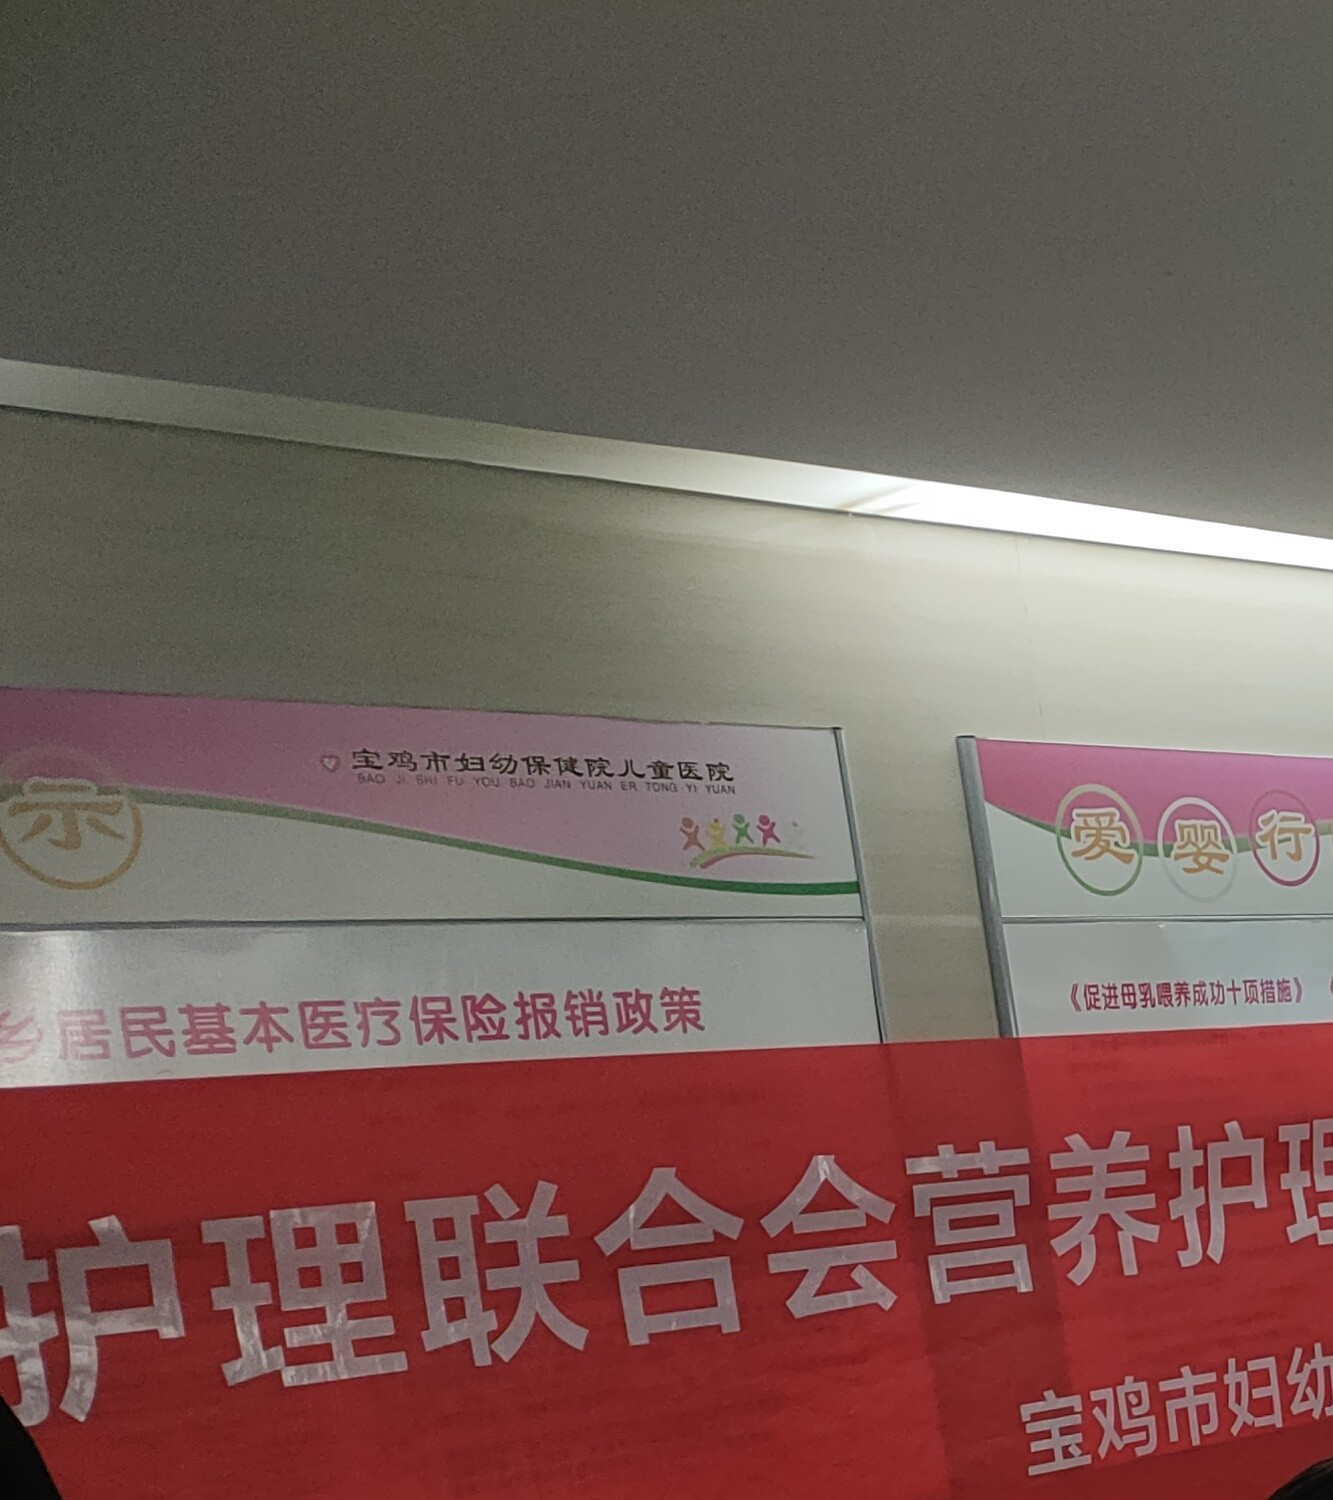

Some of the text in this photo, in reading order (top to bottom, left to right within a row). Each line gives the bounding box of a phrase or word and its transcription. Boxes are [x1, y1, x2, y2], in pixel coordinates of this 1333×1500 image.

[352, 747, 735, 782] 宝鸡市妇幼保健院儿童医院
[358, 773, 385, 785] BAO
[472, 776, 500, 788] YOU
[510, 777, 536, 788] BAO
[544, 779, 571, 790] JIAN
[580, 780, 612, 791] YUAN
[621, 781, 638, 792] ER
[646, 781, 678, 793] TONG
[705, 783, 736, 795] YUAN
[7, 782, 124, 851] 示
[1070, 976, 1303, 1012] 《促进母乳喂养成功十项措施》
